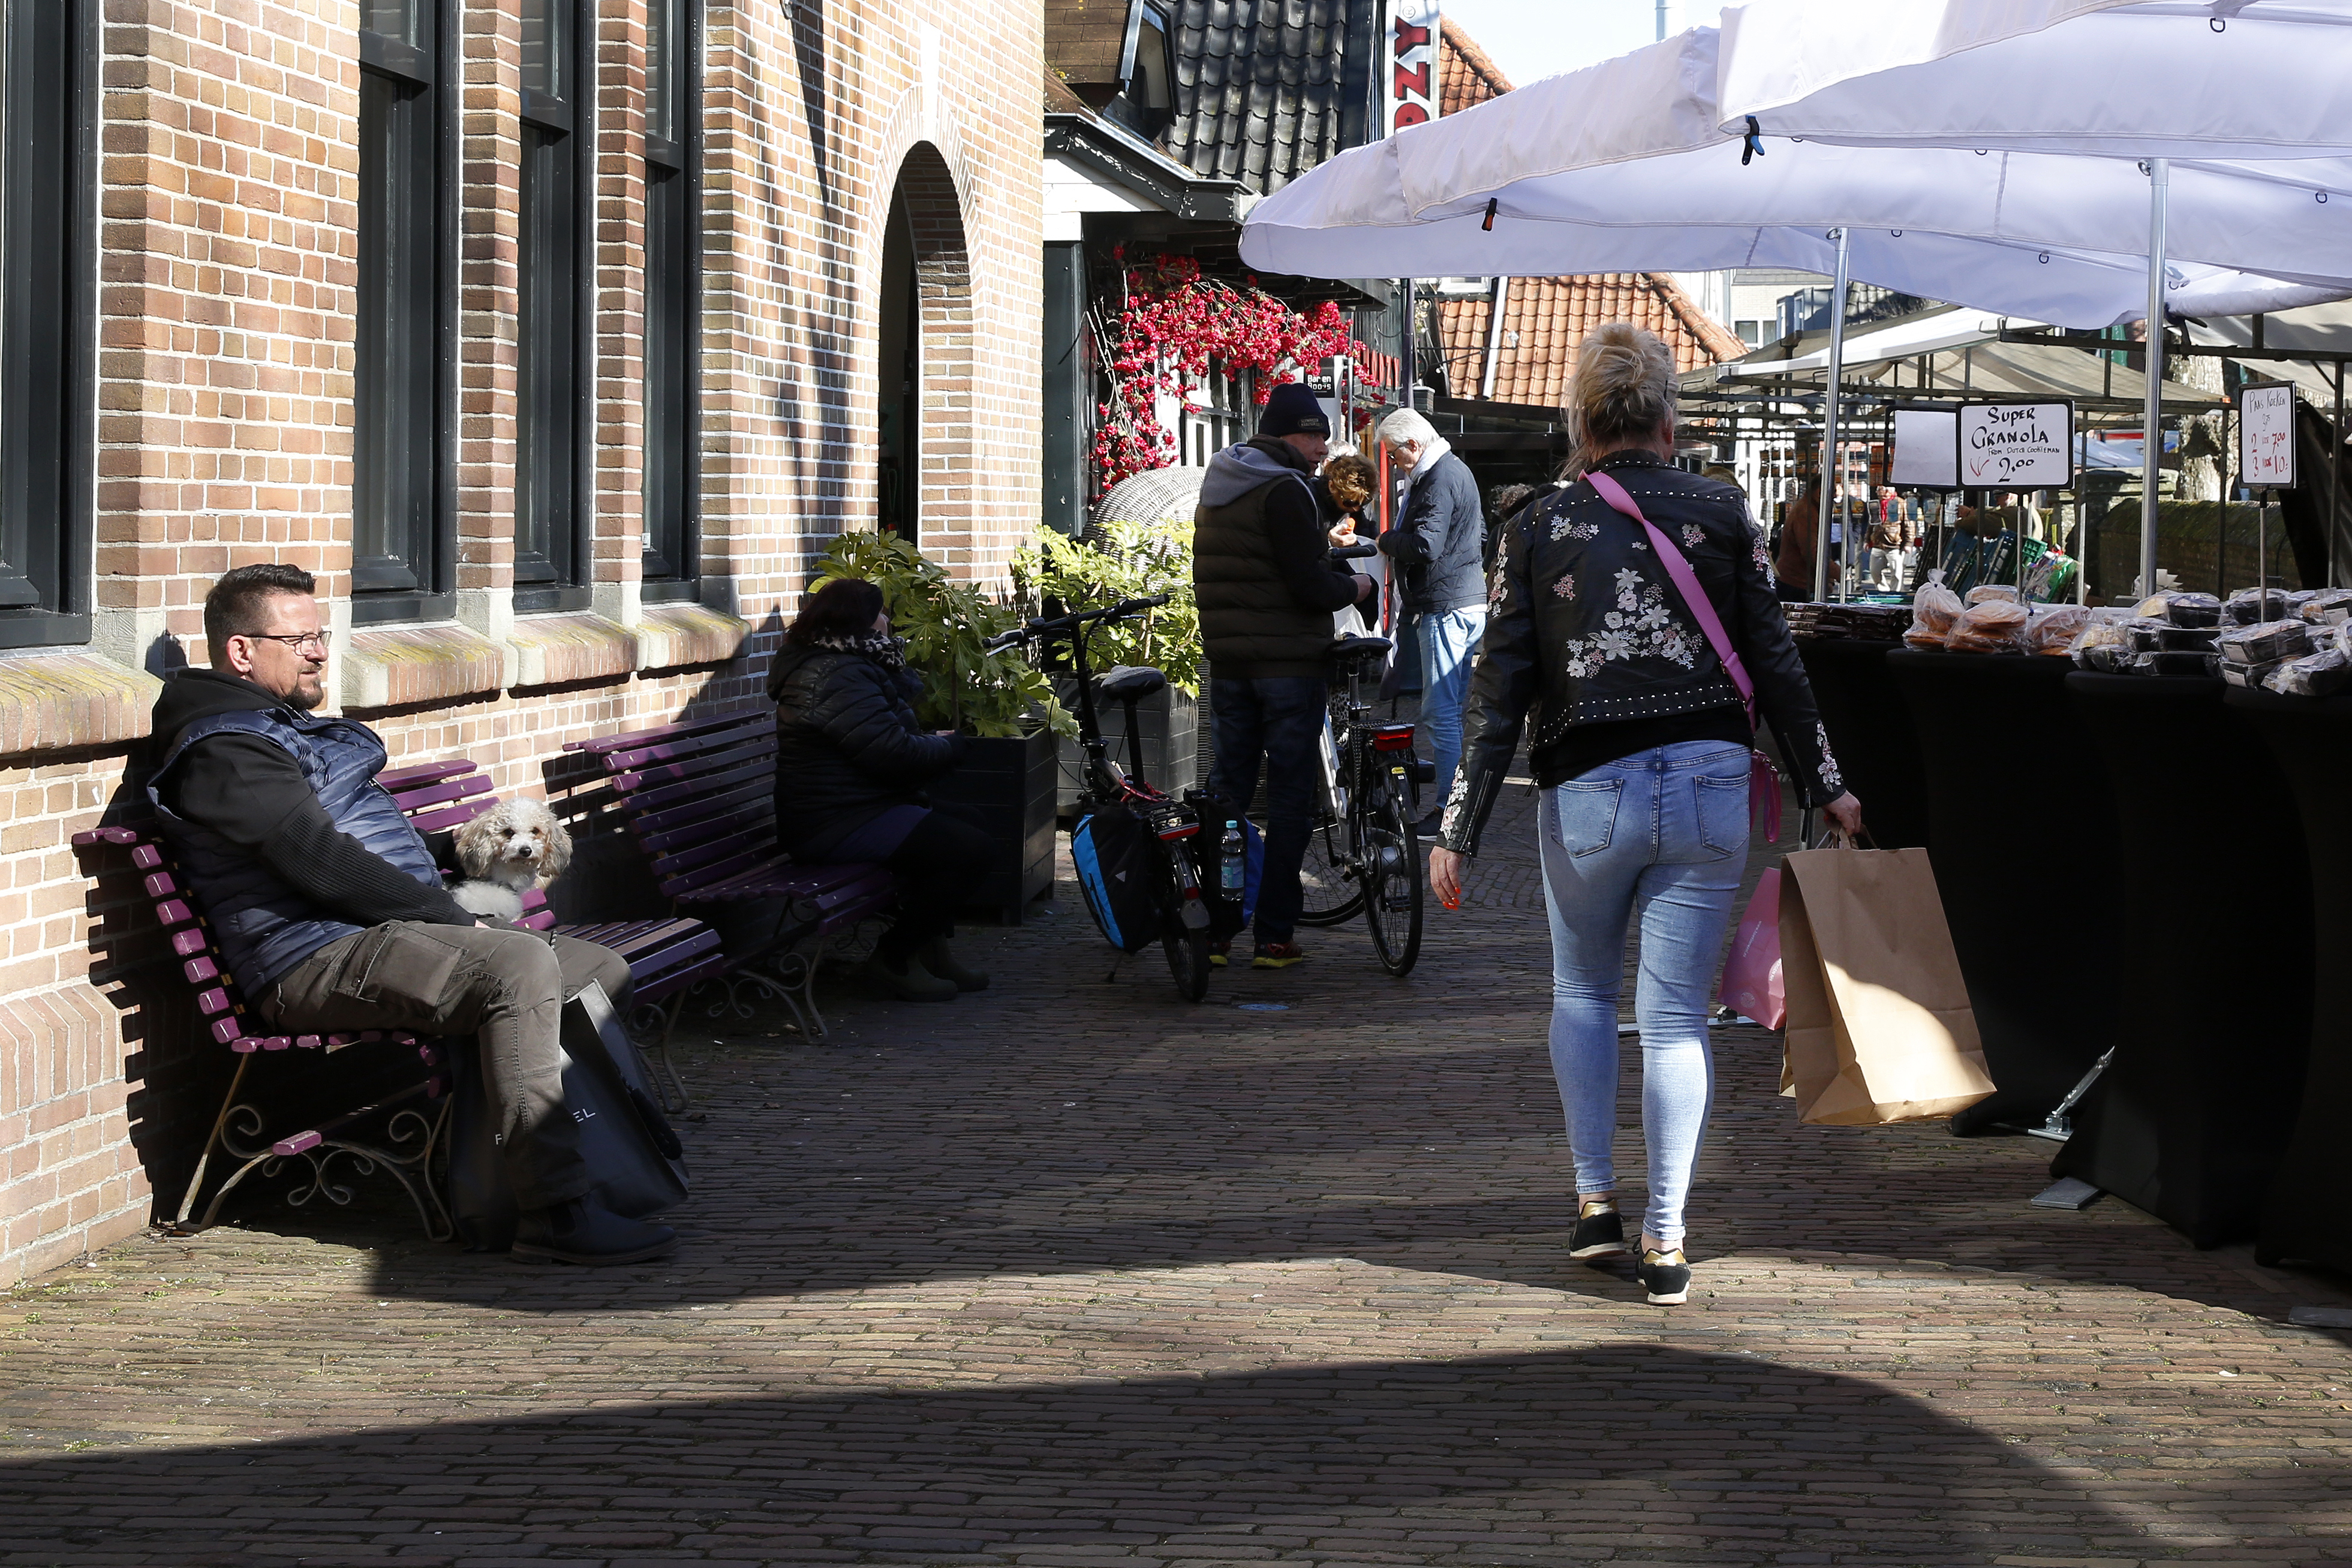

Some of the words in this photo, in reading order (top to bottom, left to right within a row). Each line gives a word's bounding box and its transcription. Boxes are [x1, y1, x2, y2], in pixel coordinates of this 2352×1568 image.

[1987, 407, 2035, 427] SUPER
[1971, 423, 2049, 449] GRANOLA
[2251, 433, 2258, 453] 2
[1988, 447, 2002, 456] FROM
[2252, 456, 2259, 477] 3
